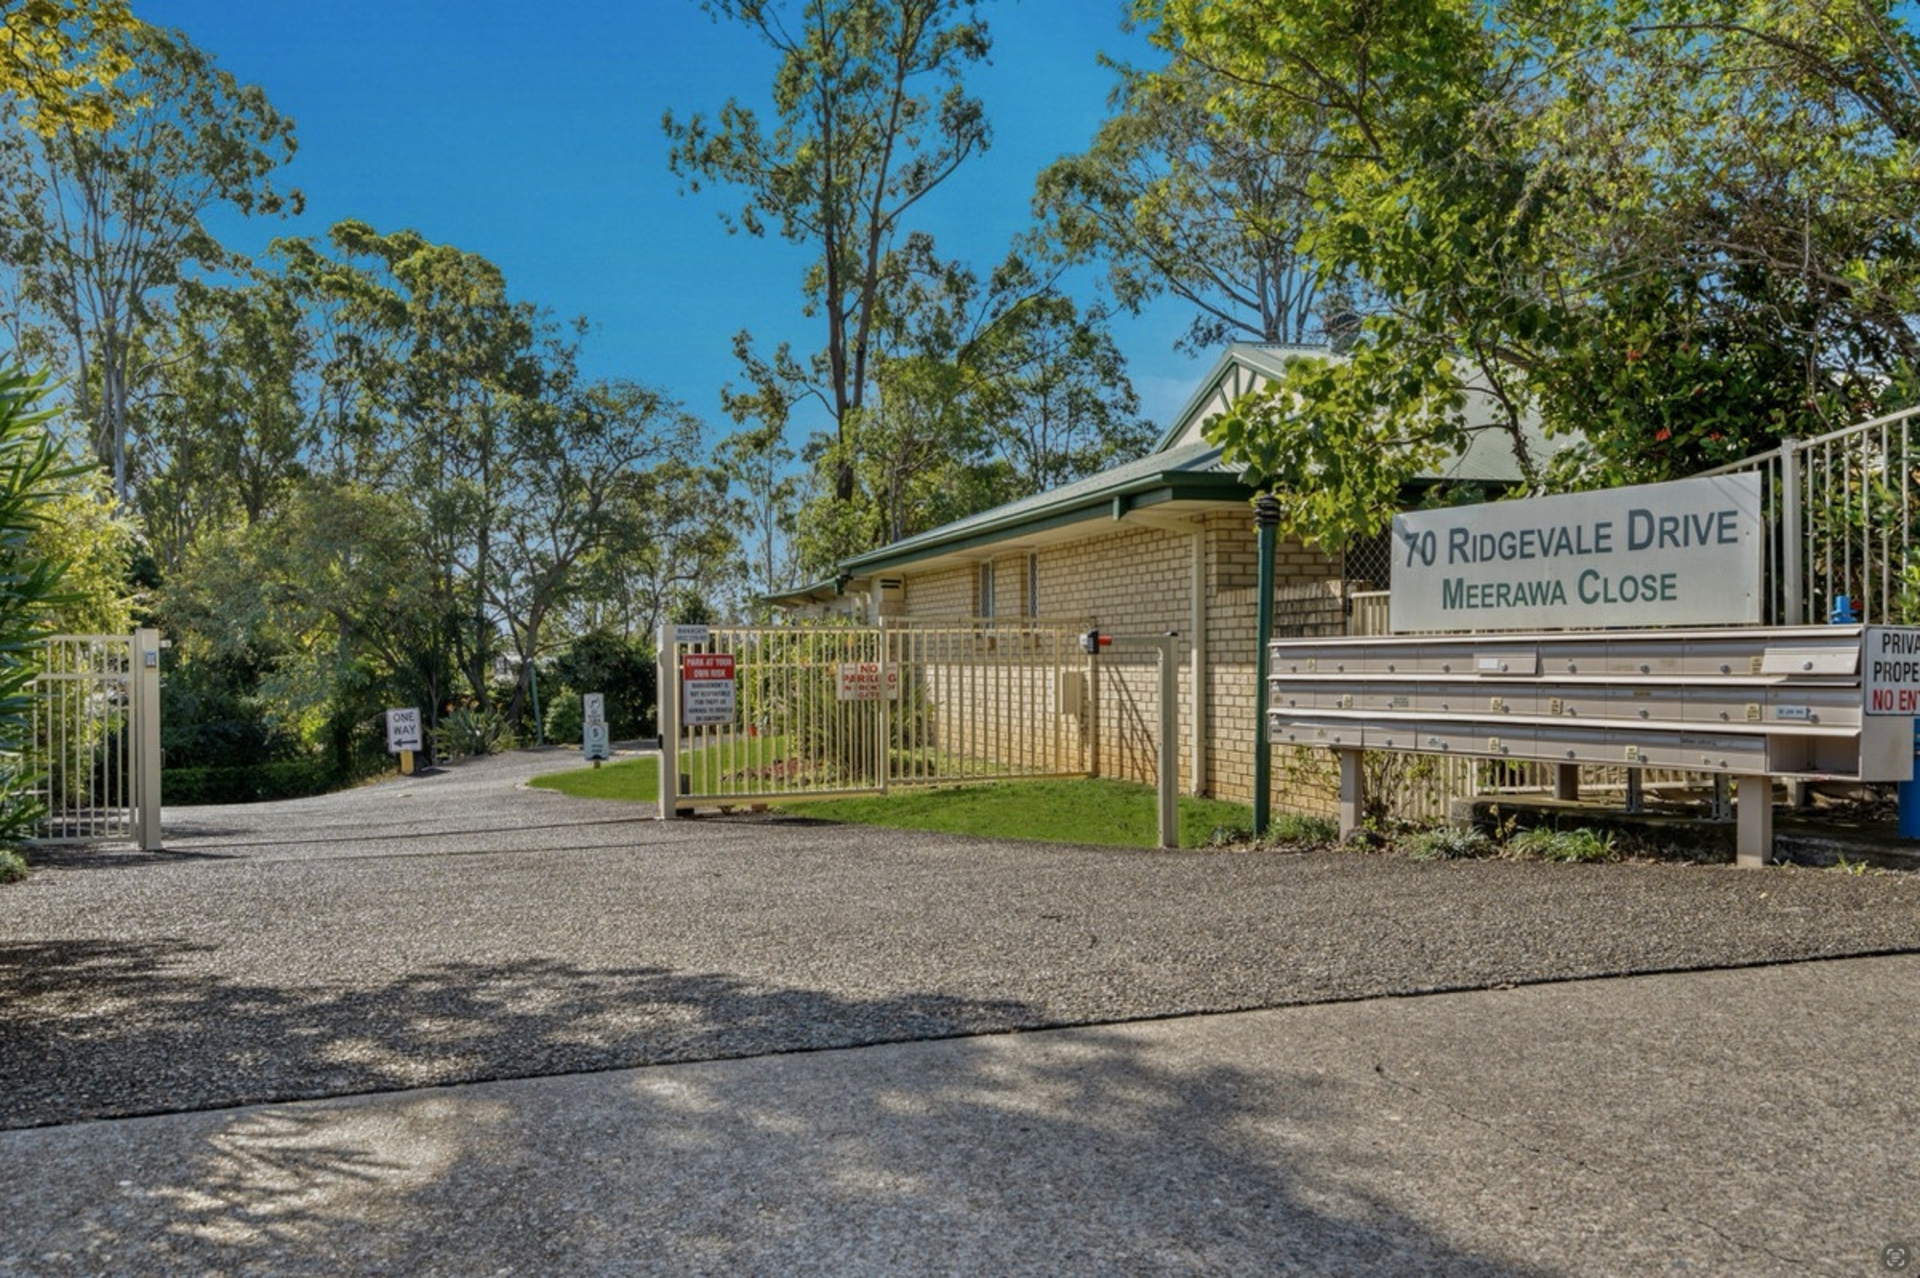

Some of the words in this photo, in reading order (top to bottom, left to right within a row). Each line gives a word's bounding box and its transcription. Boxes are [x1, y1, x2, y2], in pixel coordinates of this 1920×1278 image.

[1404, 530, 1437, 568] 70
[1448, 521, 1613, 565] RIDGEVALE
[1627, 509, 1739, 551] DRIVE
[1442, 577, 1567, 610] MEERAWA
[1578, 569, 1677, 605] CLOSE
[686, 658, 704, 666] PARK
[706, 658, 713, 666] AT
[716, 658, 732, 666] YOUR
[694, 669, 709, 678] OWN
[710, 669, 726, 678] RISK
[860, 664, 878, 673] NO
[843, 674, 897, 682] PARKIG
[1872, 689, 1893, 711] NO
[393, 711, 415, 722] ONE
[393, 725, 416, 735] WAY
